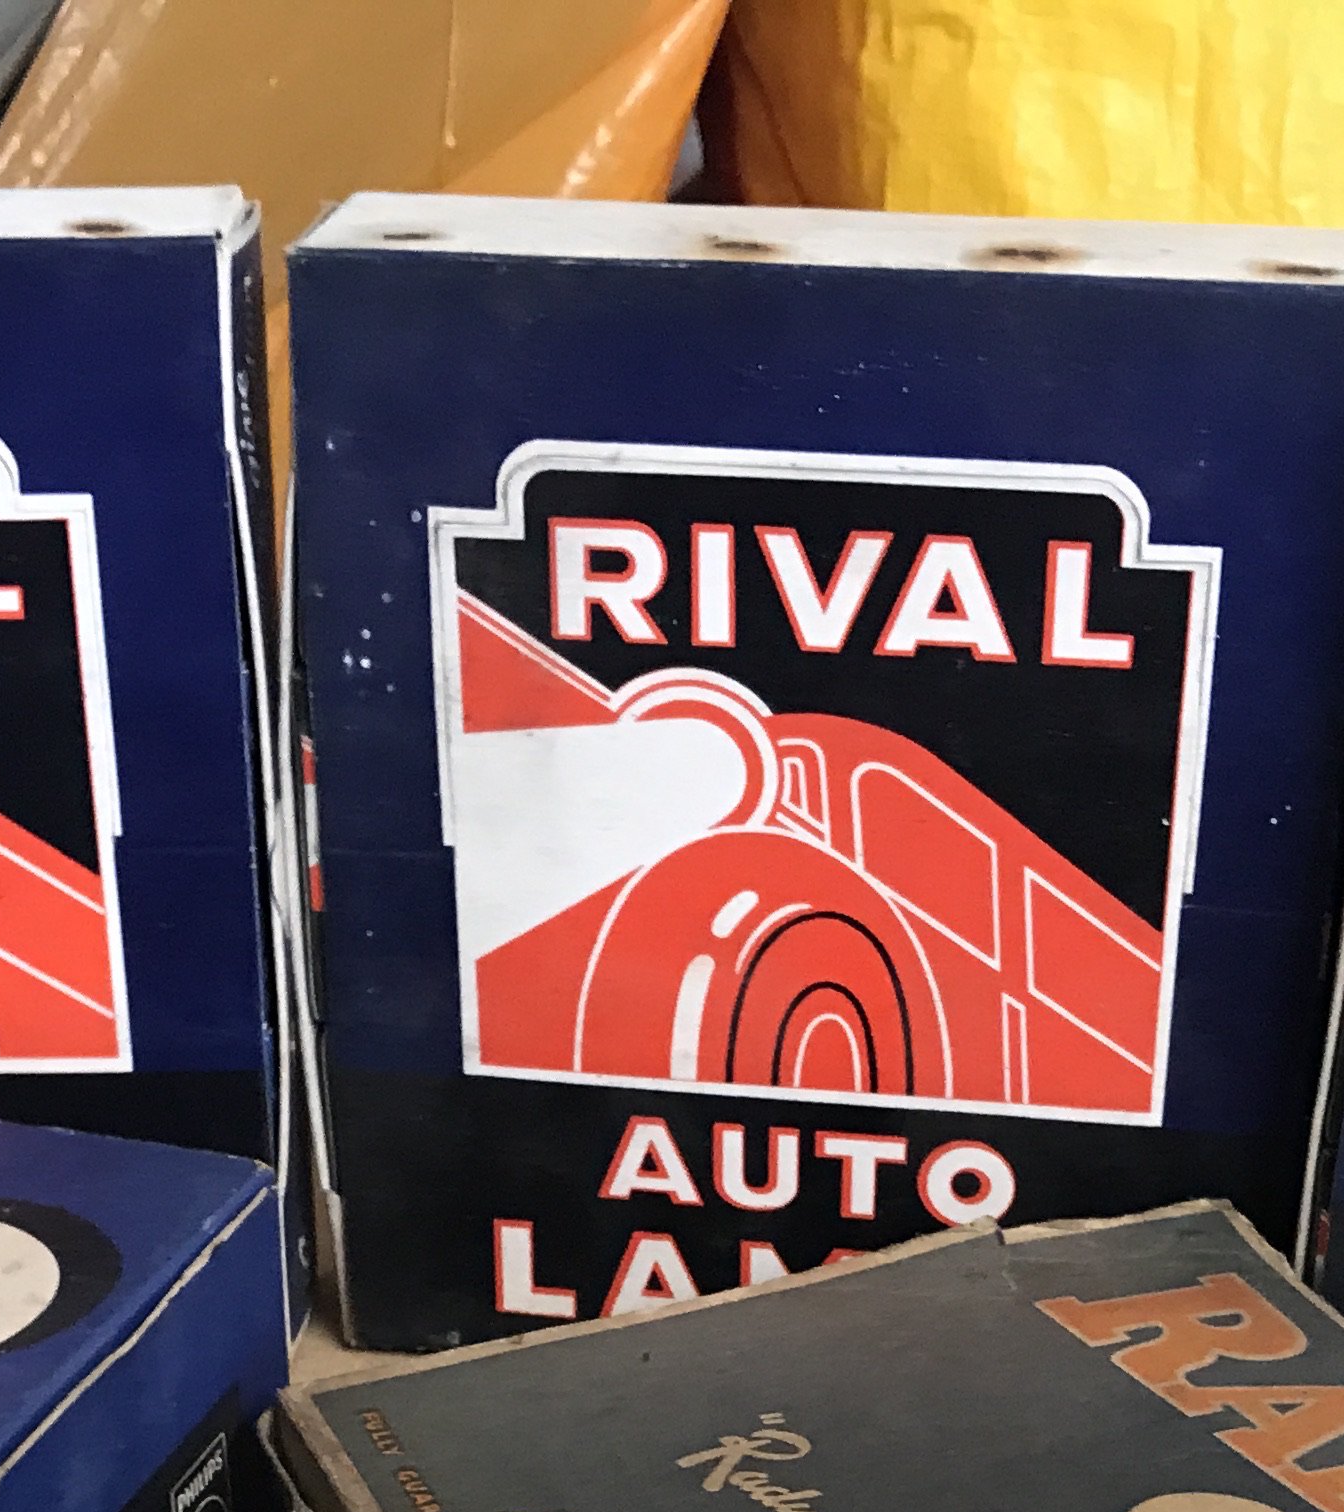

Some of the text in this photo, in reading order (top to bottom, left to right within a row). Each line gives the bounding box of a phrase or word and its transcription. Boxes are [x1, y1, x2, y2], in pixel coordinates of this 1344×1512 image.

[547, 517, 1135, 669] RIVAL
[597, 1115, 1016, 1229] AUTO
[360, 1410, 405, 1456] FULLY
